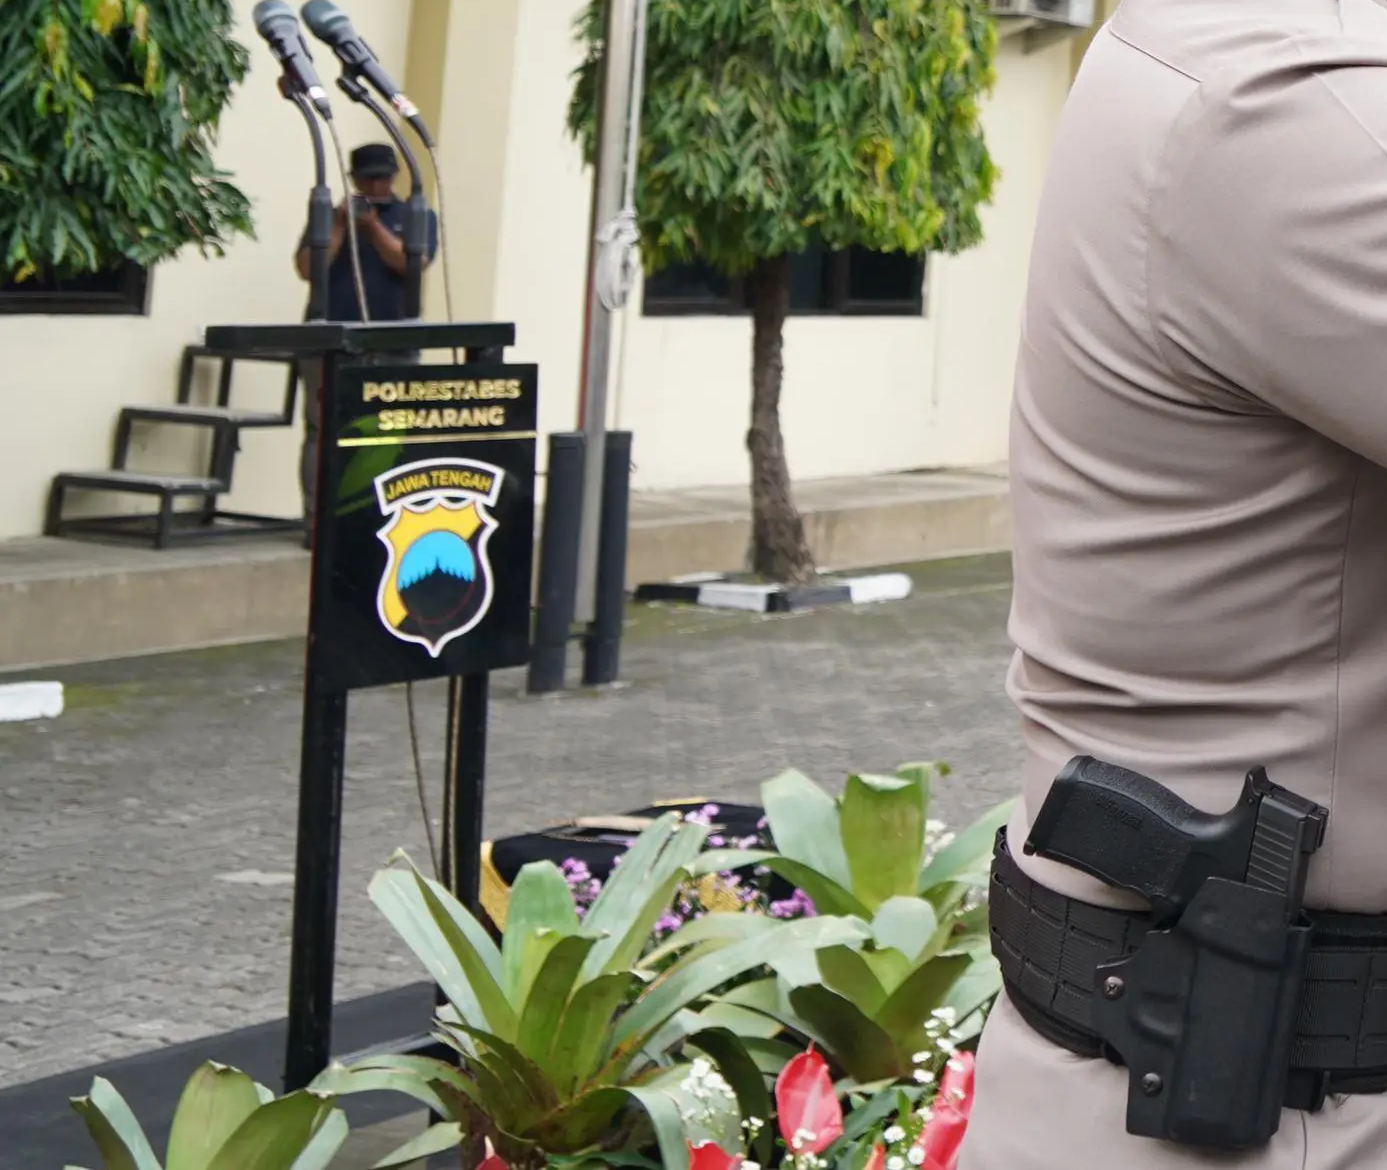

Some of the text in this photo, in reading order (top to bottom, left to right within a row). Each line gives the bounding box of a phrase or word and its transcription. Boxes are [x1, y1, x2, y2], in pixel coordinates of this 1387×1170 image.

[362, 379, 522, 402] POLRESTABES
[377, 405, 505, 430] SEMARANG
[386, 469, 493, 501] JAWA TENGAH
